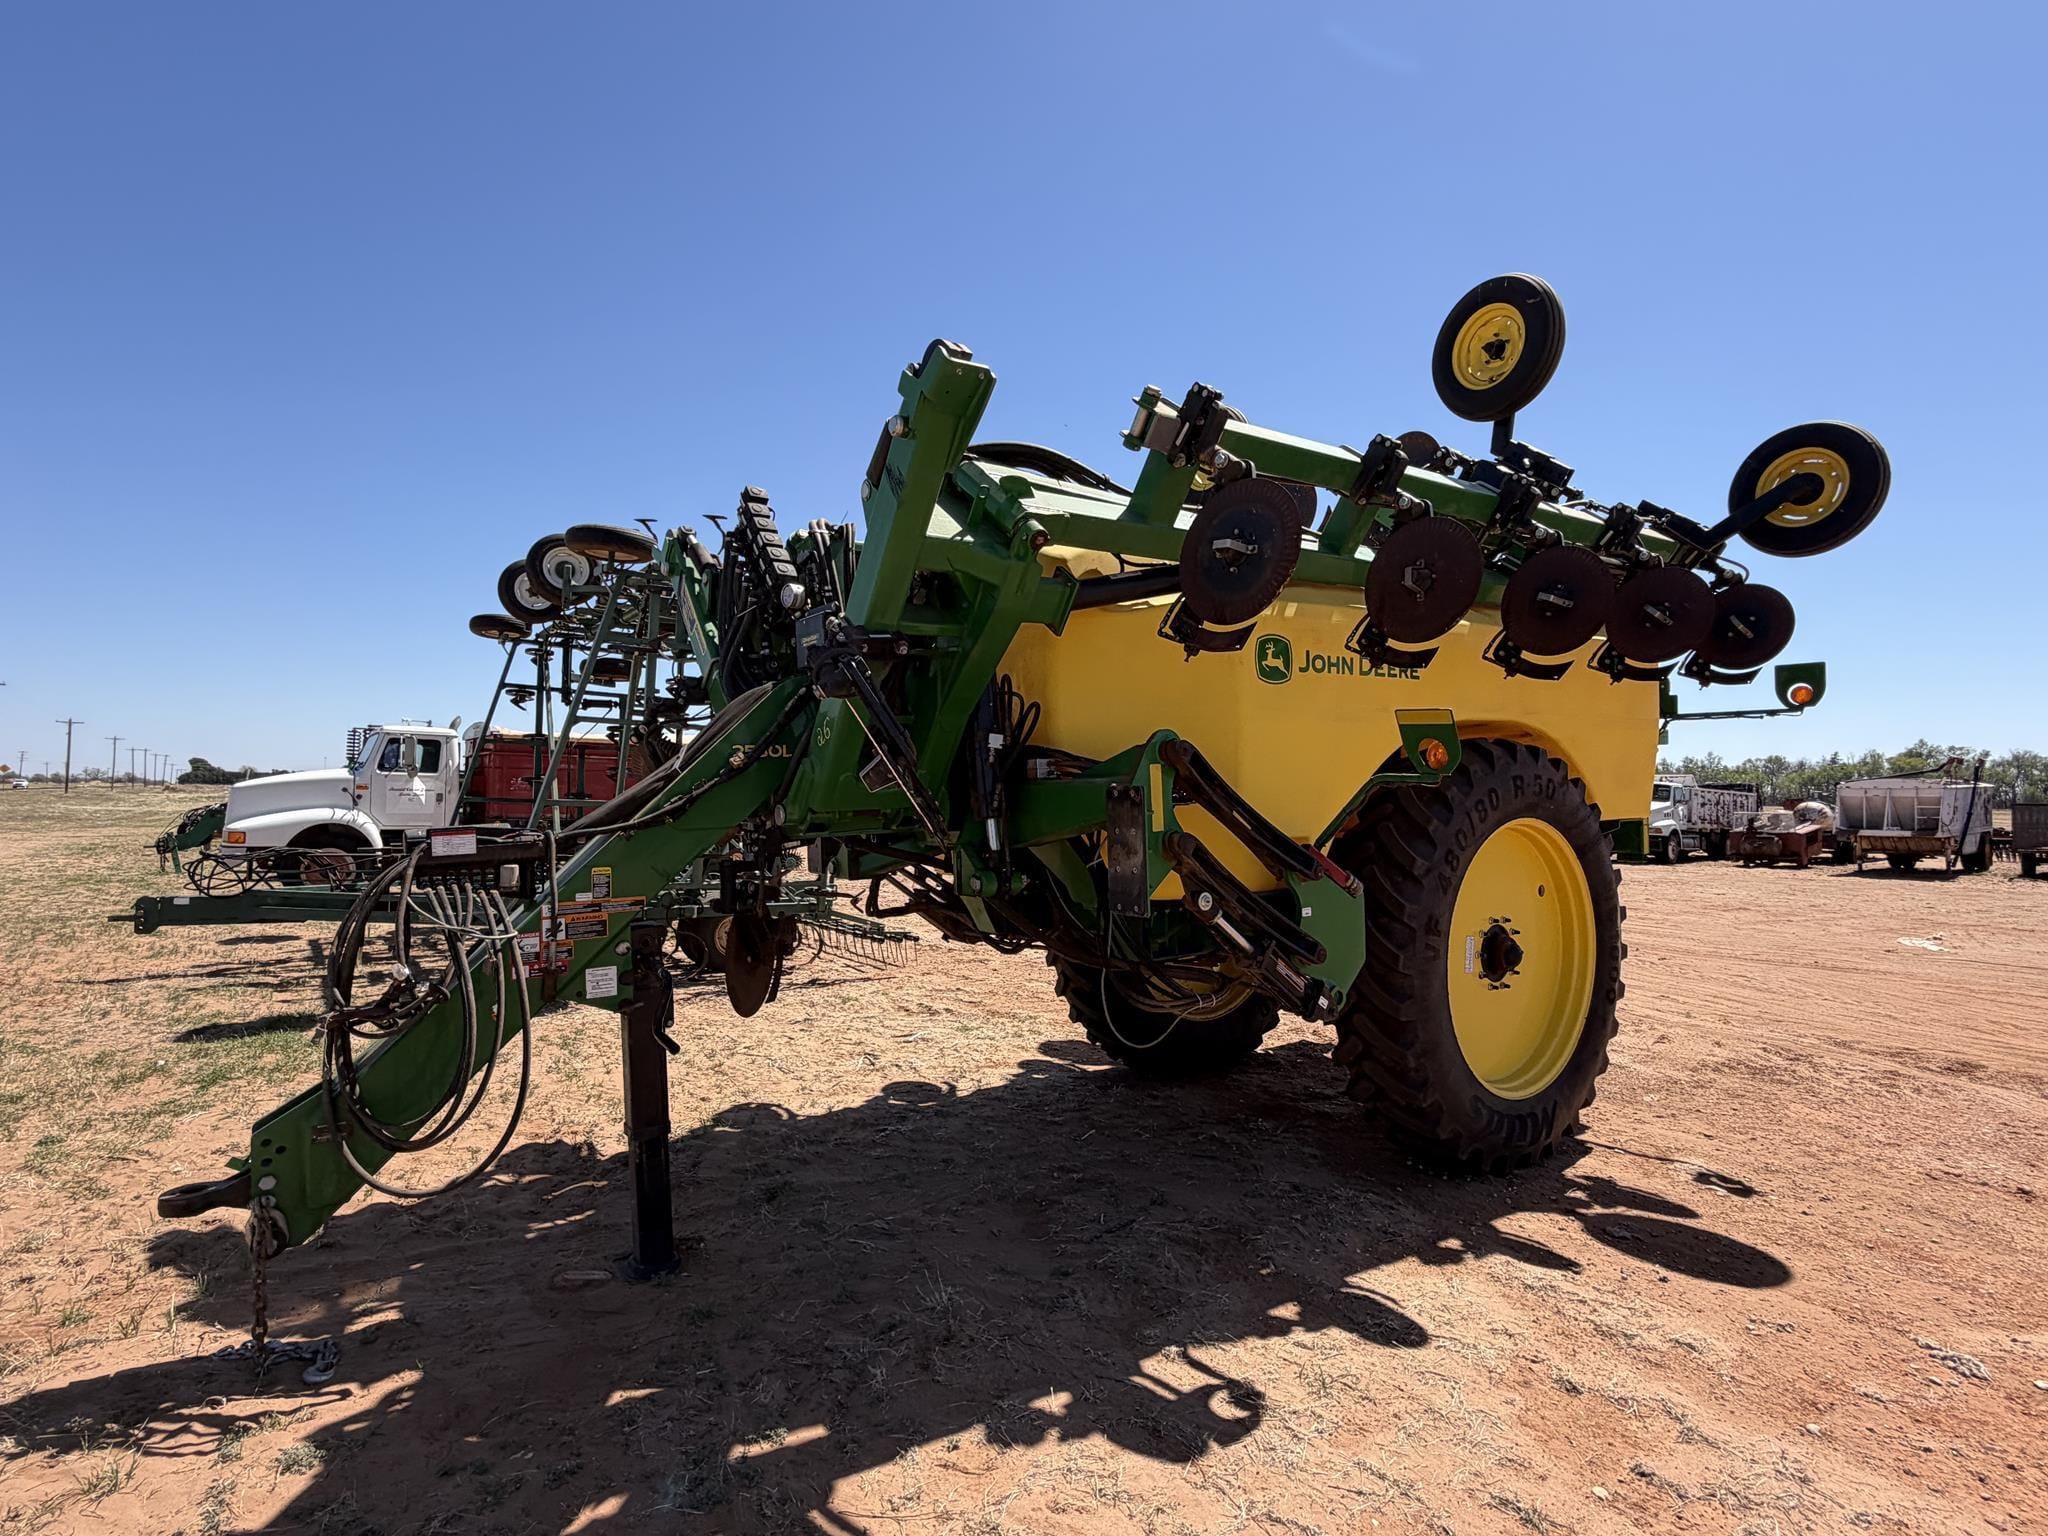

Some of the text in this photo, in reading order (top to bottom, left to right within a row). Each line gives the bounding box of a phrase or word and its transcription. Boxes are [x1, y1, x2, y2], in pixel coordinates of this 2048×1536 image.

[1298, 650, 1420, 680] JOHN DEERE
[1437, 787, 1500, 896] 480/80
